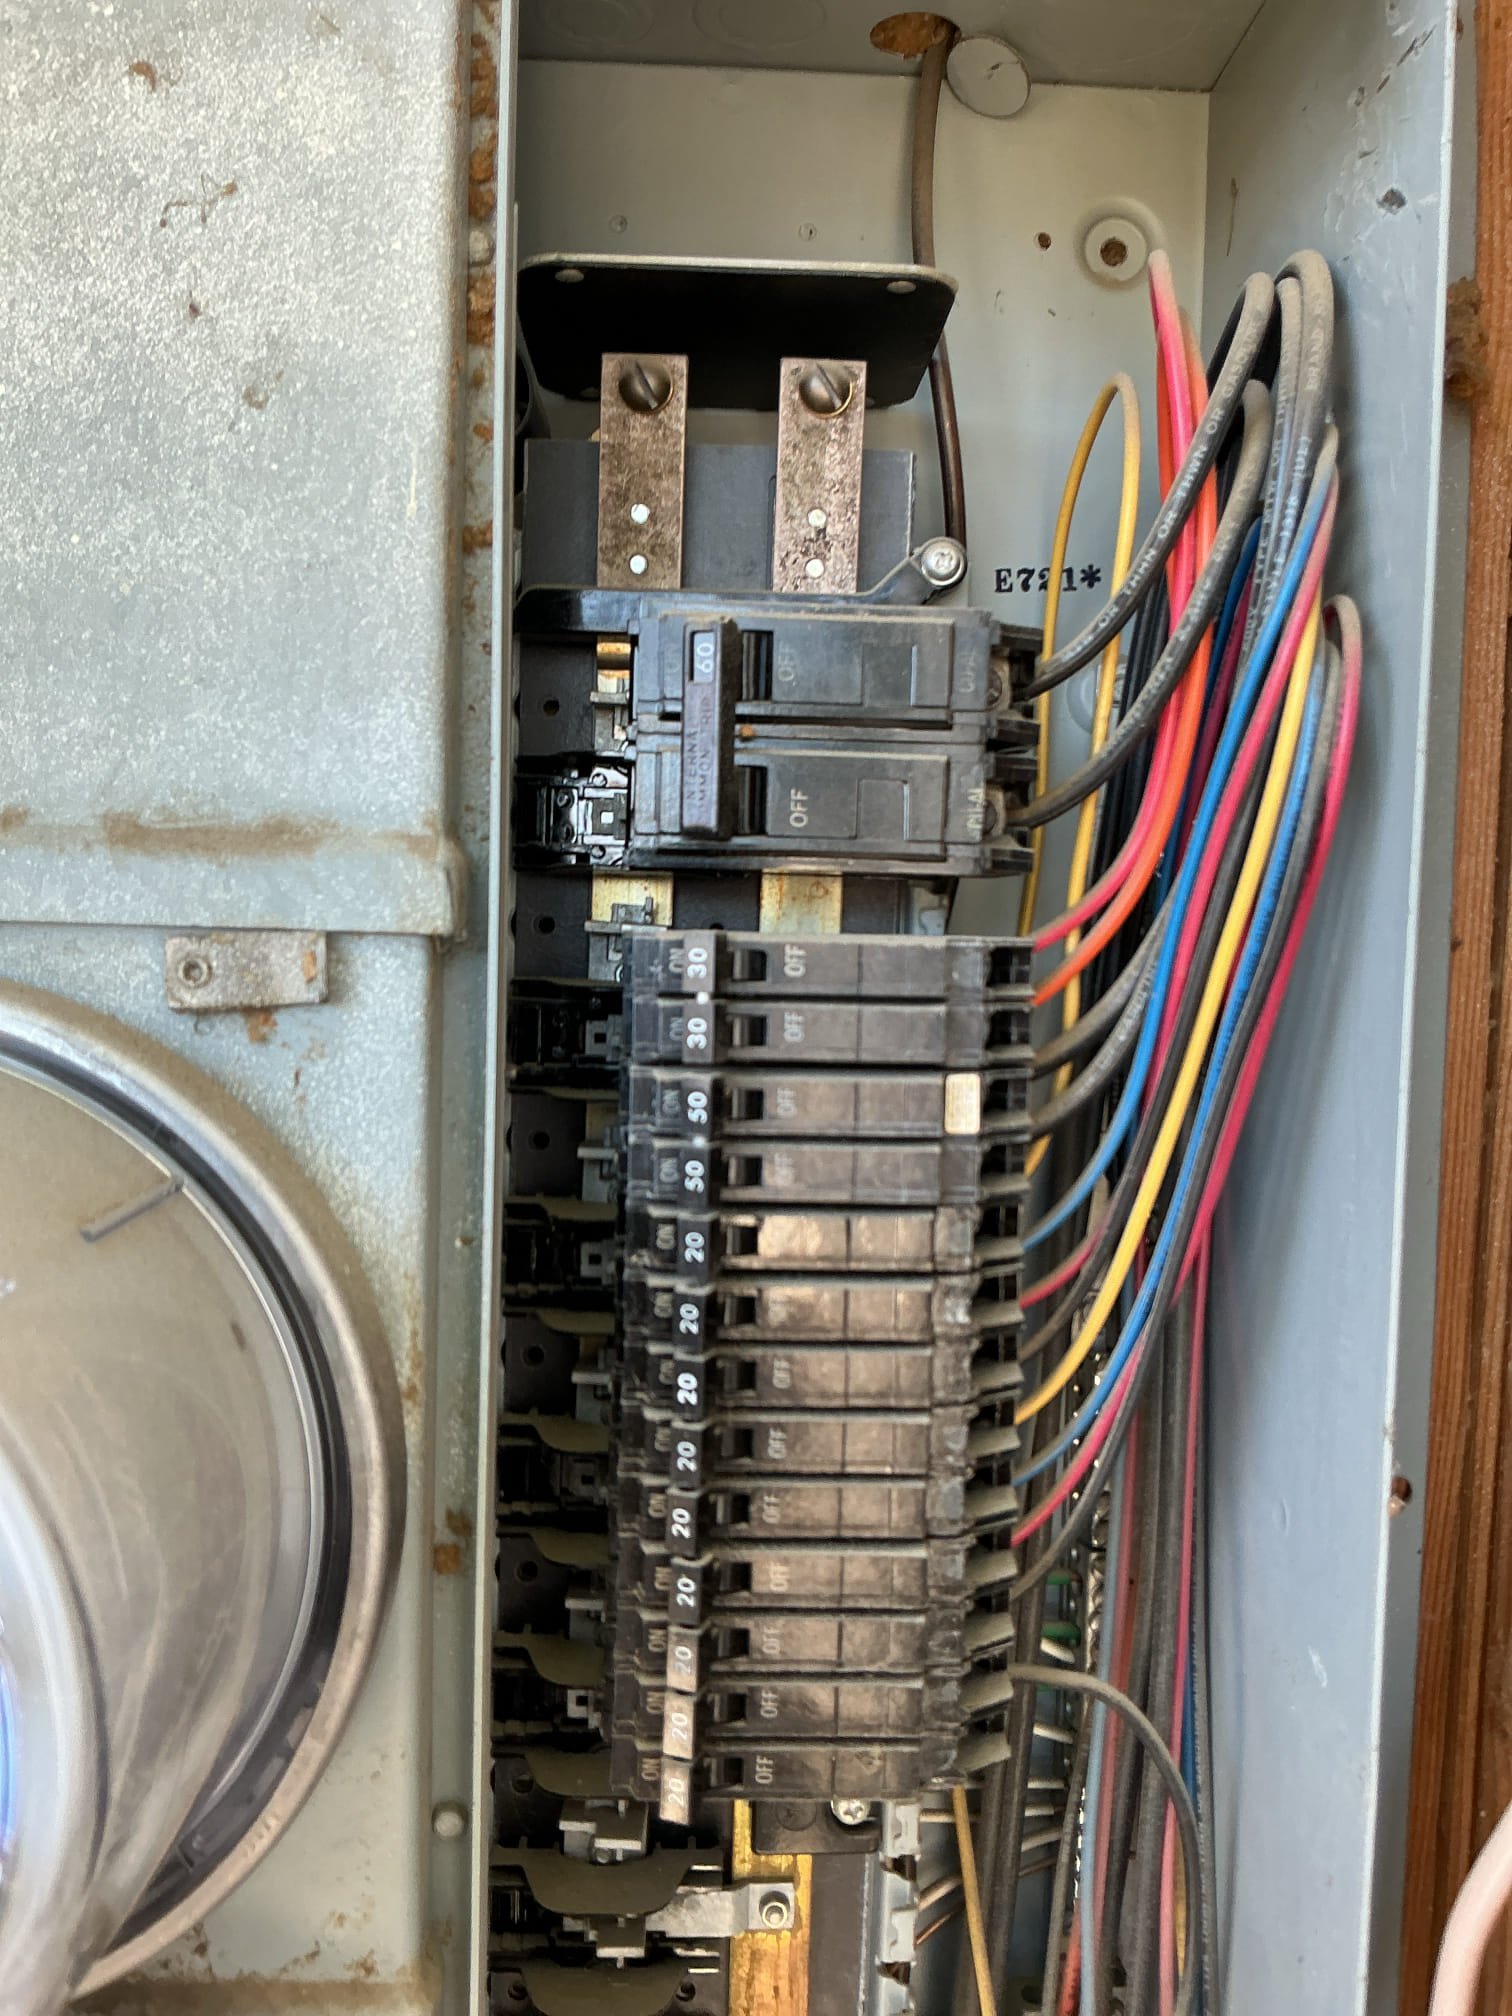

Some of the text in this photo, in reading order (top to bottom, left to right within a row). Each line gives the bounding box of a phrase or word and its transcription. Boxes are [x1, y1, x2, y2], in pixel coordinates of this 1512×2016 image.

[1099, 604, 1119, 628] OR
[1122, 549, 1157, 595] THHN
[1158, 511, 1178, 538] OR
[1174, 445, 1208, 500] THWN
[1205, 407, 1224, 434] OR
[696, 642, 714, 673] 60
[778, 640, 795, 682] OFF
[790, 788, 808, 828] OFF
[669, 948, 684, 973] ON
[687, 947, 708, 979] 30
[784, 943, 806, 978] OFF
[687, 1017, 708, 1050] 30
[784, 1011, 805, 1042] OFF
[687, 1091, 708, 1124] 50
[660, 1157, 679, 1183] ON
[685, 1160, 705, 1193] 50
[684, 1232, 705, 1263] 20
[679, 1303, 700, 1335] 20
[772, 1357, 792, 1389] OFF
[677, 1372, 698, 1406] 20
[676, 1441, 697, 1473] 20
[768, 1427, 787, 1459] OFF
[762, 1490, 781, 1524] OFF
[671, 1507, 691, 1539] 20
[769, 1561, 789, 1592] OFF
[676, 1577, 696, 1608] 20
[648, 1629, 666, 1652] ON
[762, 1624, 781, 1654] OFF
[674, 1646, 692, 1675] 20
[646, 1691, 664, 1714] ON
[760, 1689, 778, 1718] OFF
[671, 1712, 688, 1741] 20
[641, 1757, 660, 1781] ON
[755, 1754, 774, 1785] OFF
[668, 1778, 685, 1807] 20
